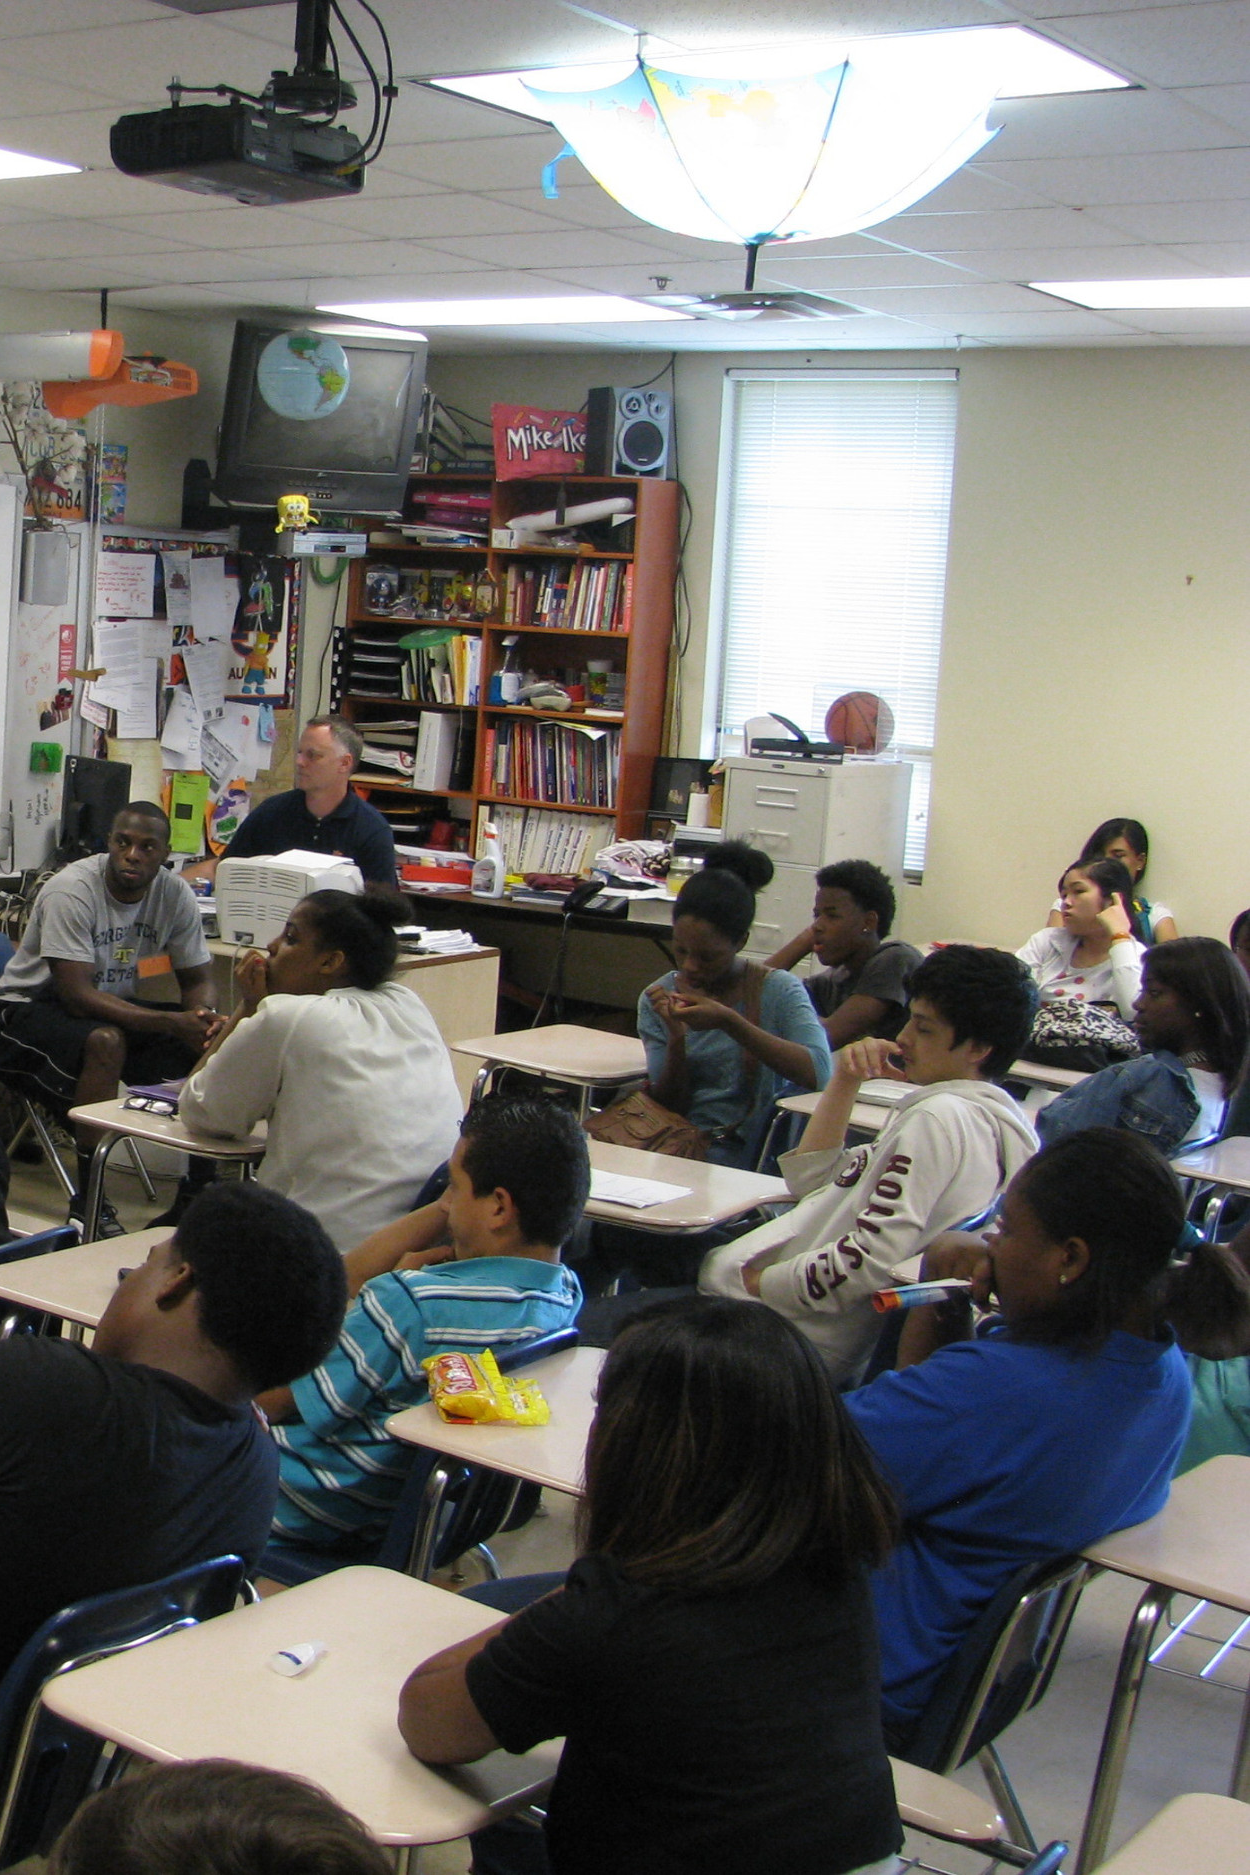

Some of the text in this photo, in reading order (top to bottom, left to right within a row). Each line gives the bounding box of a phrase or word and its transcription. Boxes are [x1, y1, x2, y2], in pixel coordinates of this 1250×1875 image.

[507, 424, 553, 461] Mike
[561, 425, 586, 453] Ike
[228, 667, 277, 680] AUN
